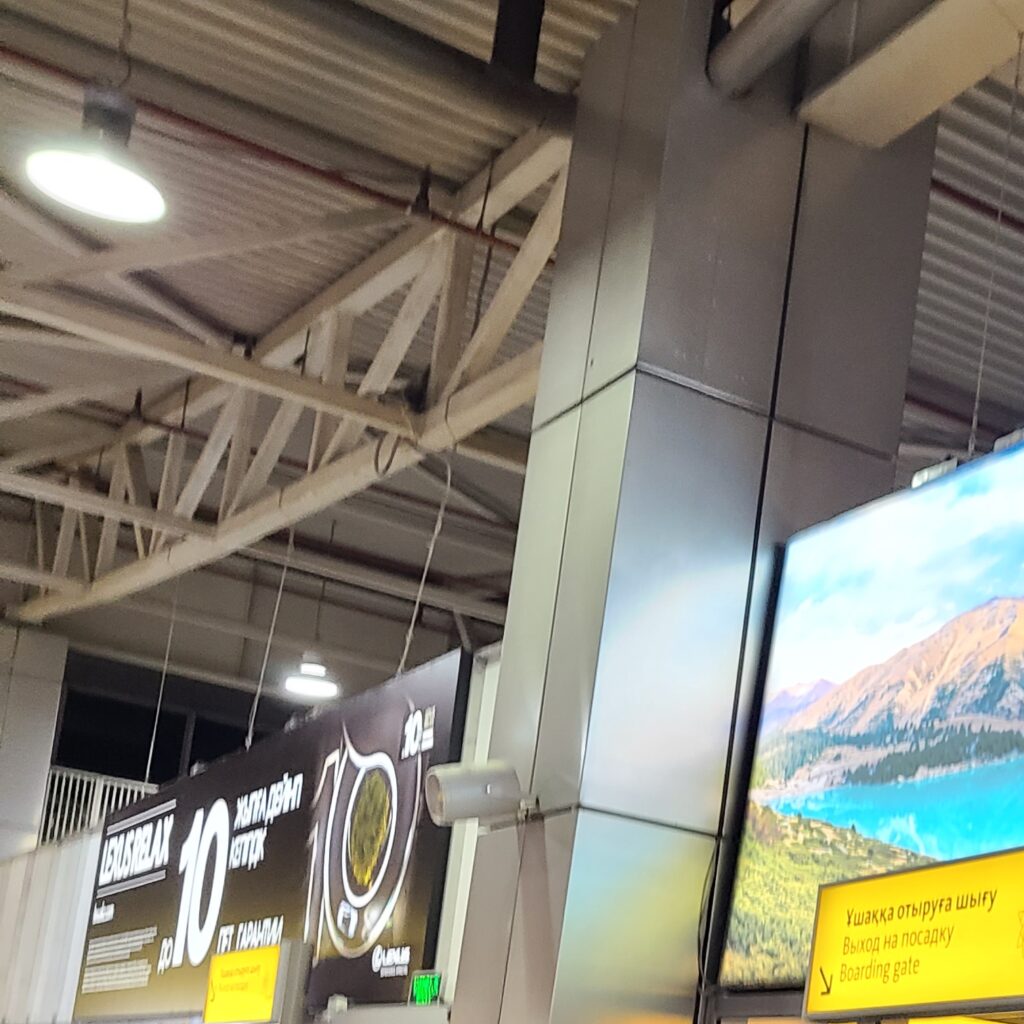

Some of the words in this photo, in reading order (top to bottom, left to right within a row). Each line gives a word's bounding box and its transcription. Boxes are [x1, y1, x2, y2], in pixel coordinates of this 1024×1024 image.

[178, 798, 230, 968] 10
[842, 935, 880, 956] Выход
[883, 933, 898, 951] на
[902, 925, 955, 949] посадку
[840, 958, 891, 984] Boarding
[893, 956, 920, 983] gate
